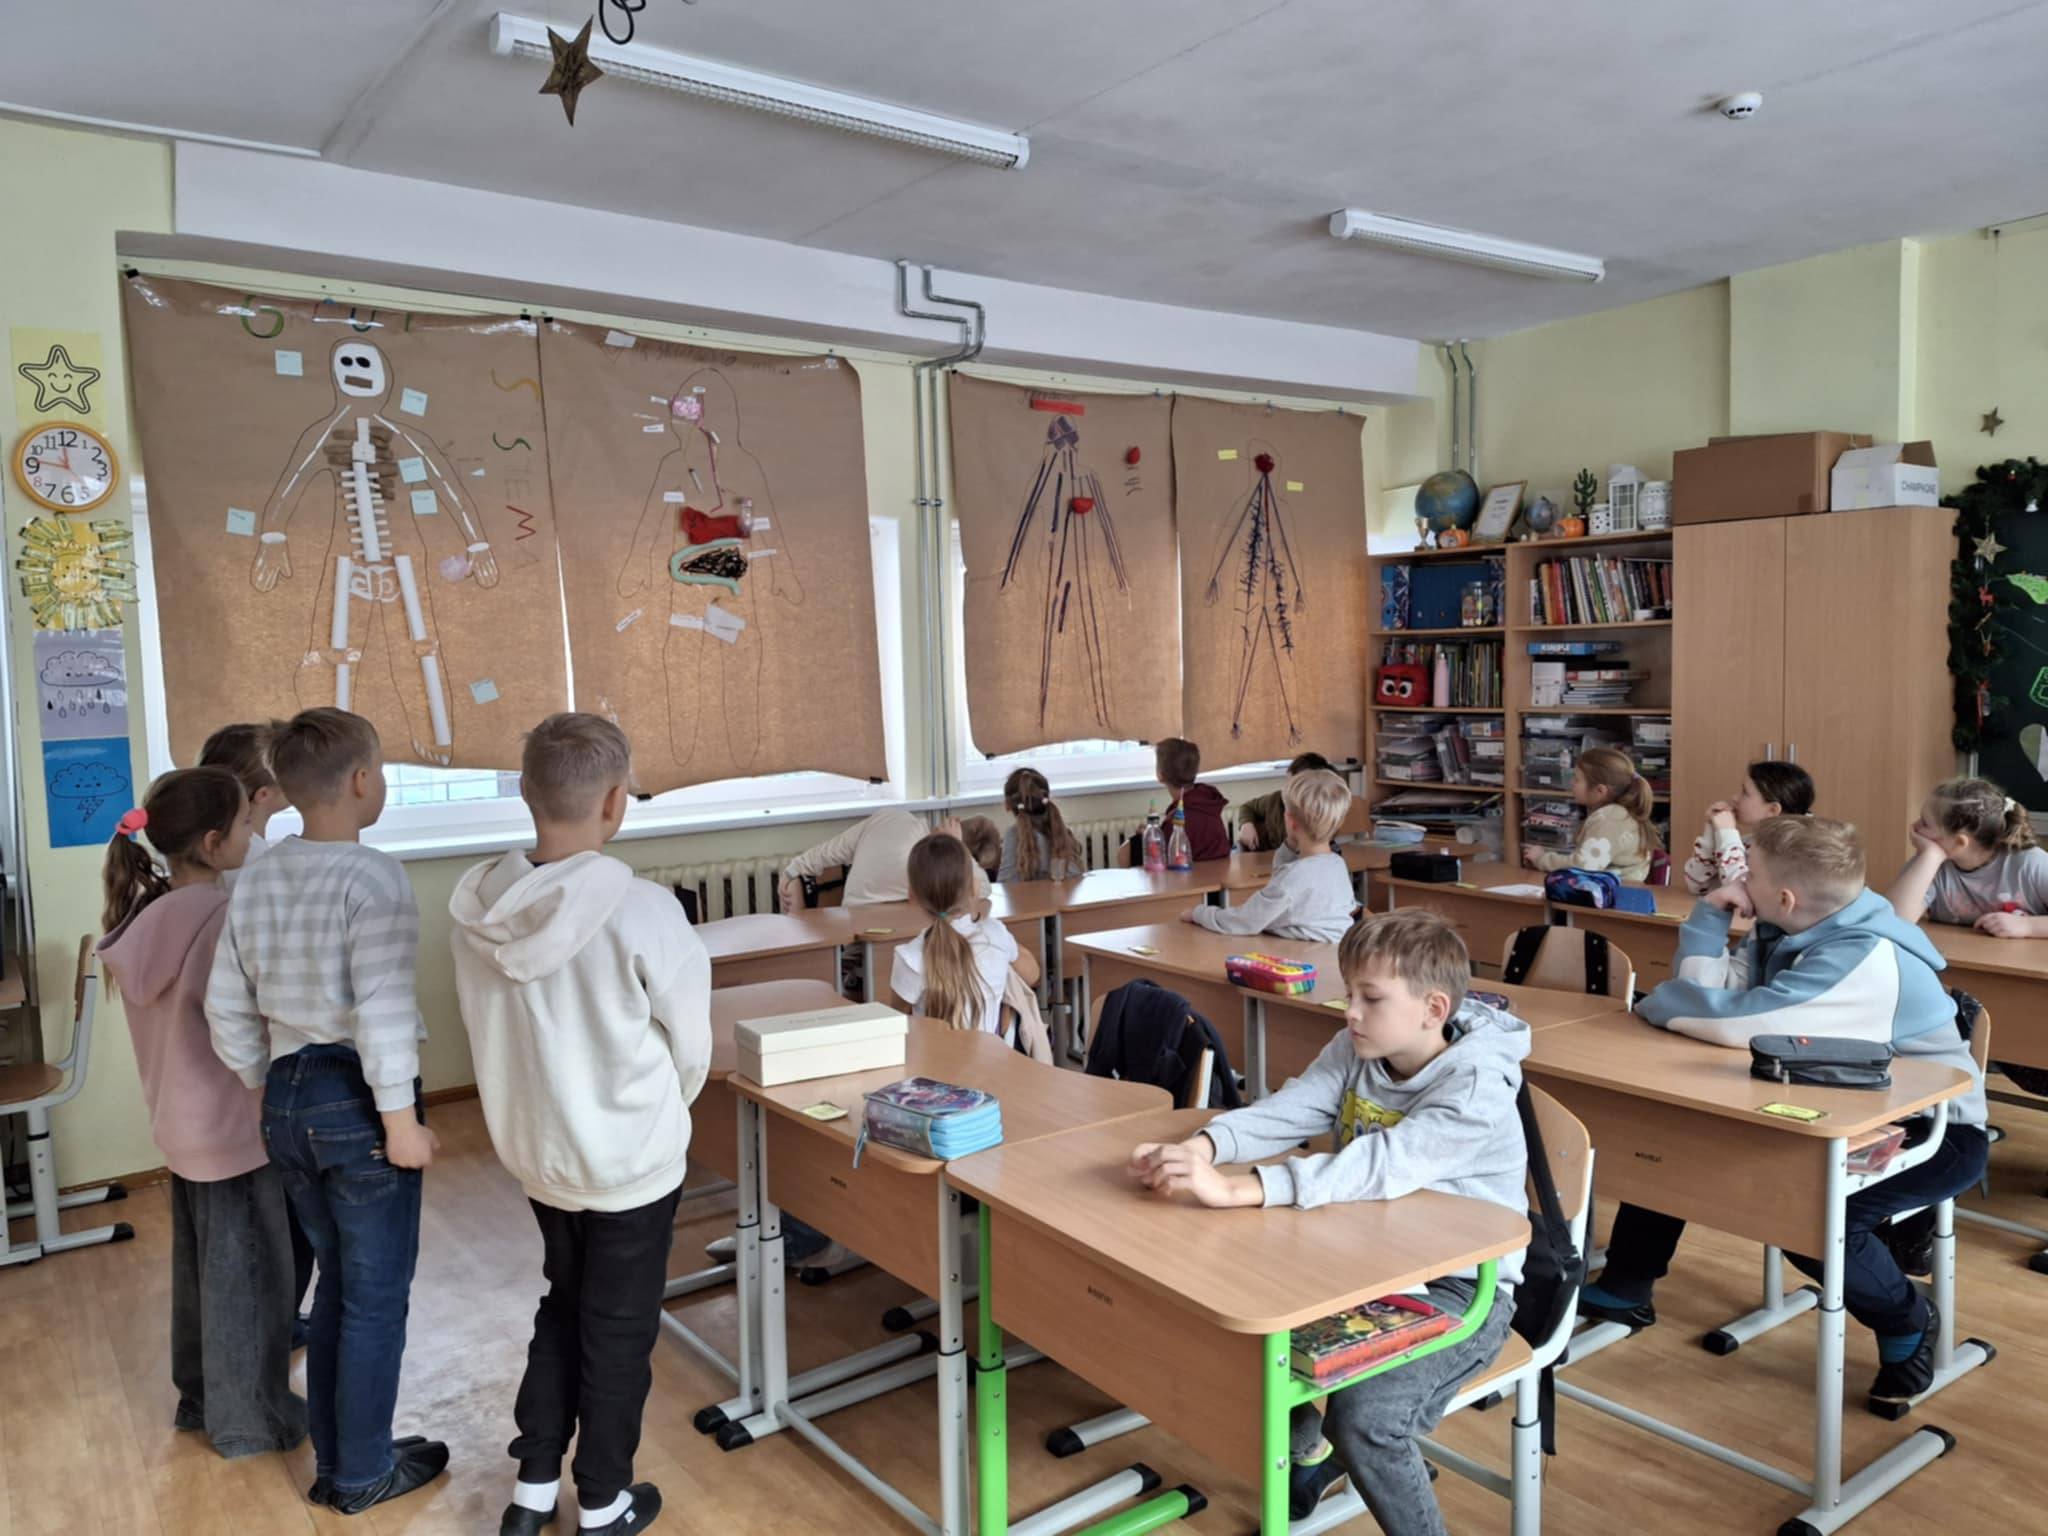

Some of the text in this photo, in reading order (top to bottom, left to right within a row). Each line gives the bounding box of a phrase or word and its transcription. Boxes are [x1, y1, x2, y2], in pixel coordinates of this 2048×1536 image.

[44, 435, 58, 450] 11
[58, 430, 78, 448] 12
[82, 439, 88, 449] 1
[31, 444, 44, 456] 10
[91, 446, 102, 462] 2
[25, 456, 40, 475] 9
[96, 460, 108, 478] 3
[33, 476, 42, 487] 8
[44, 483, 57, 498] 7
[60, 485, 75, 504] 6
[80, 485, 90, 501] 5
